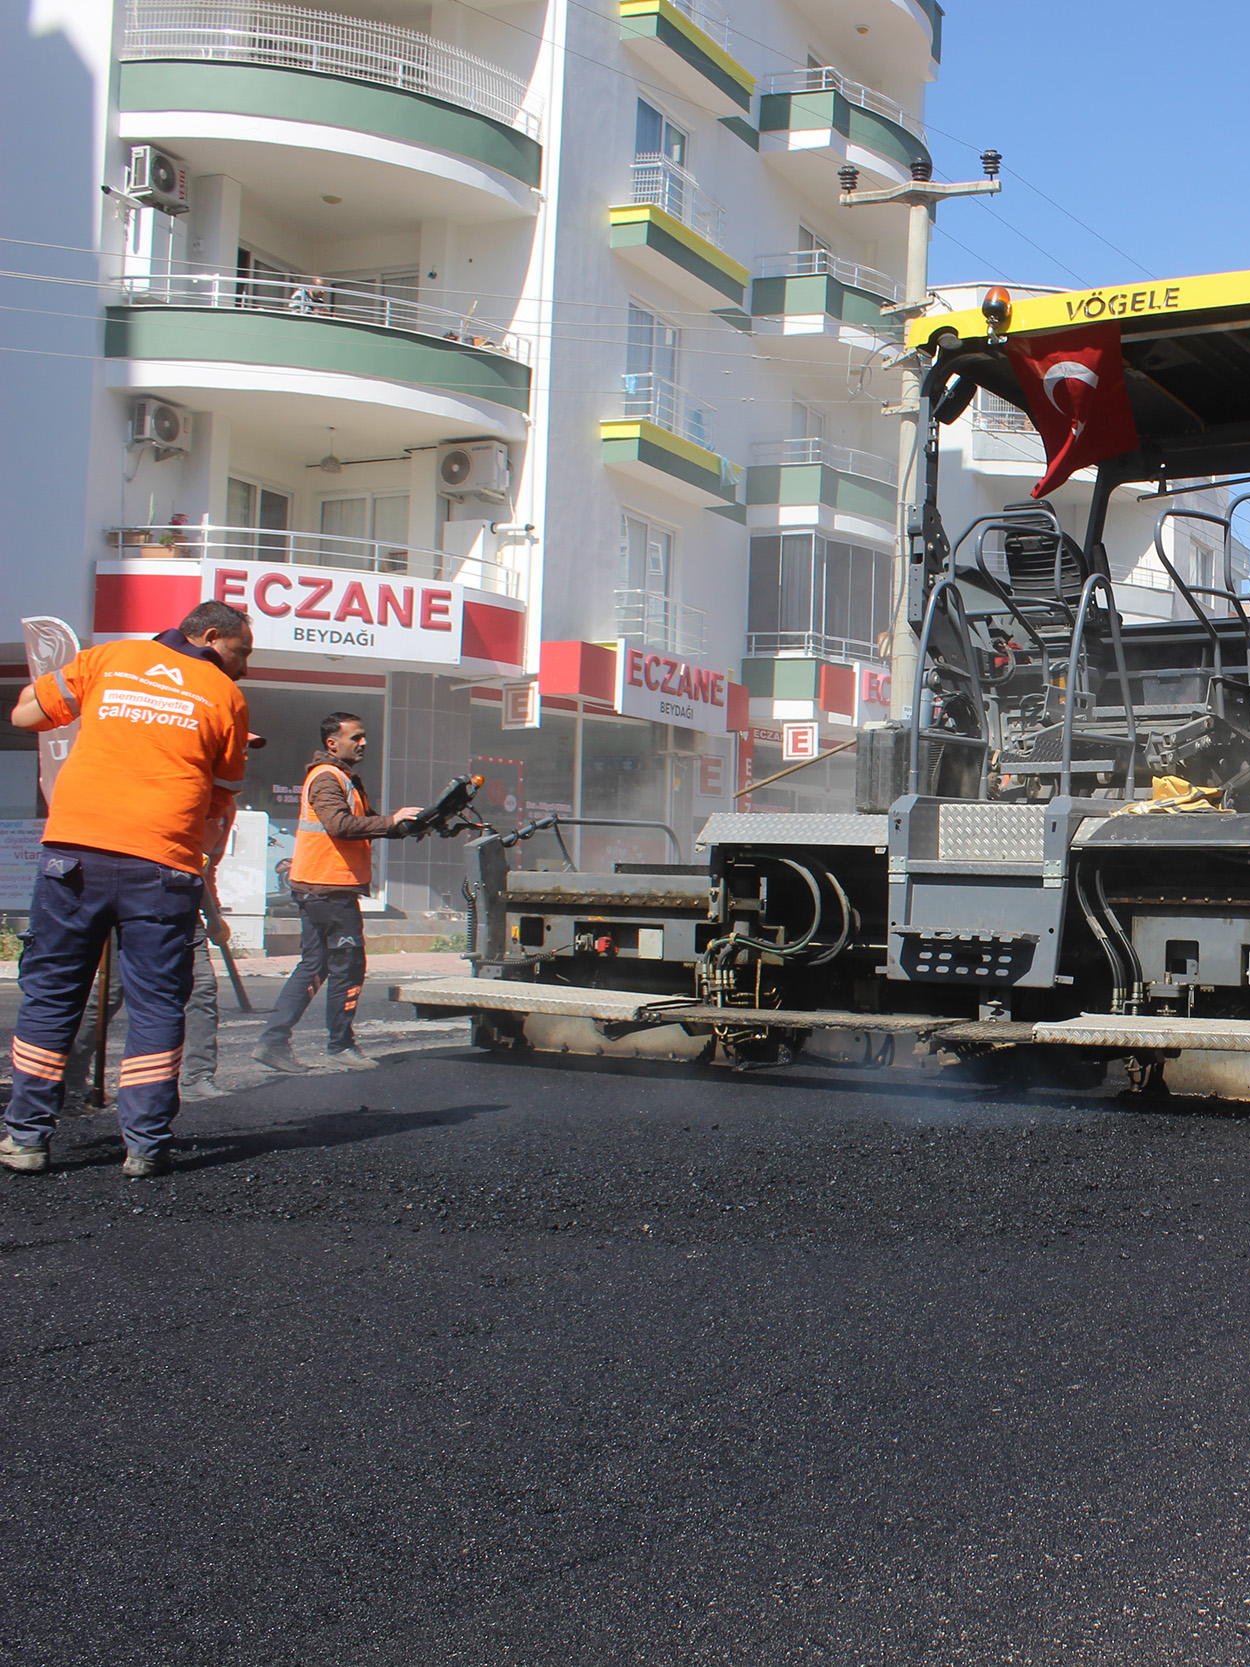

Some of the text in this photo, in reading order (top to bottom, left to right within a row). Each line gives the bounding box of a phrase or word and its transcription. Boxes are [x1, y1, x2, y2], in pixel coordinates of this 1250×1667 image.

[1066, 287, 1180, 321] VÖGELE
[213, 568, 453, 633] ECZANE
[293, 627, 375, 647] BEYDAĞI
[627, 648, 725, 708] ECZANE
[108, 692, 190, 711] memnuniyetle
[660, 701, 694, 720] BEYDAĞI
[98, 704, 200, 730] çalışıyoruz
[753, 729, 783, 741] ECZA
[792, 731, 809, 753] E
